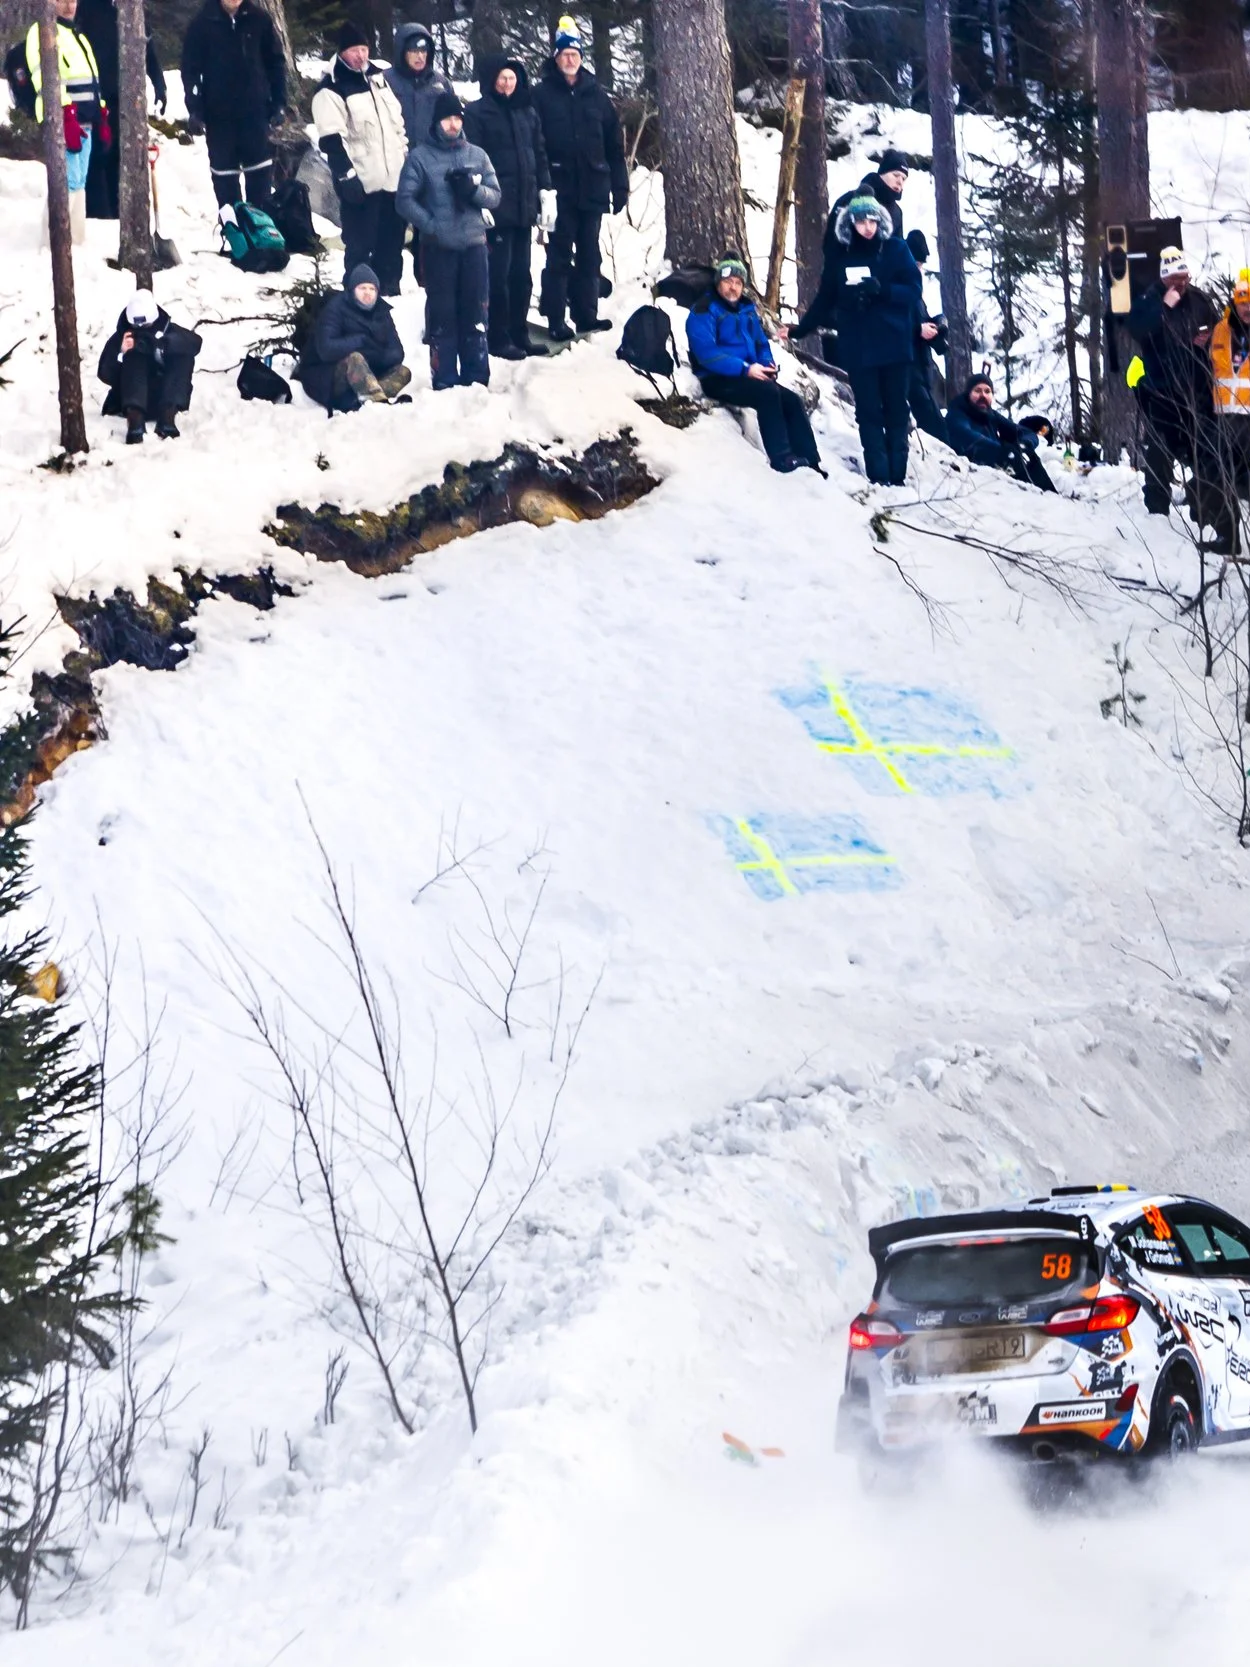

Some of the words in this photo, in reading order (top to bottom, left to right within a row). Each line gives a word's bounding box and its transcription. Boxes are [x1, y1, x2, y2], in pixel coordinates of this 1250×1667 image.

[1142, 1204, 1172, 1242] 58
[1041, 1252, 1072, 1279] 58
[1177, 1303, 1225, 1343] WRC
